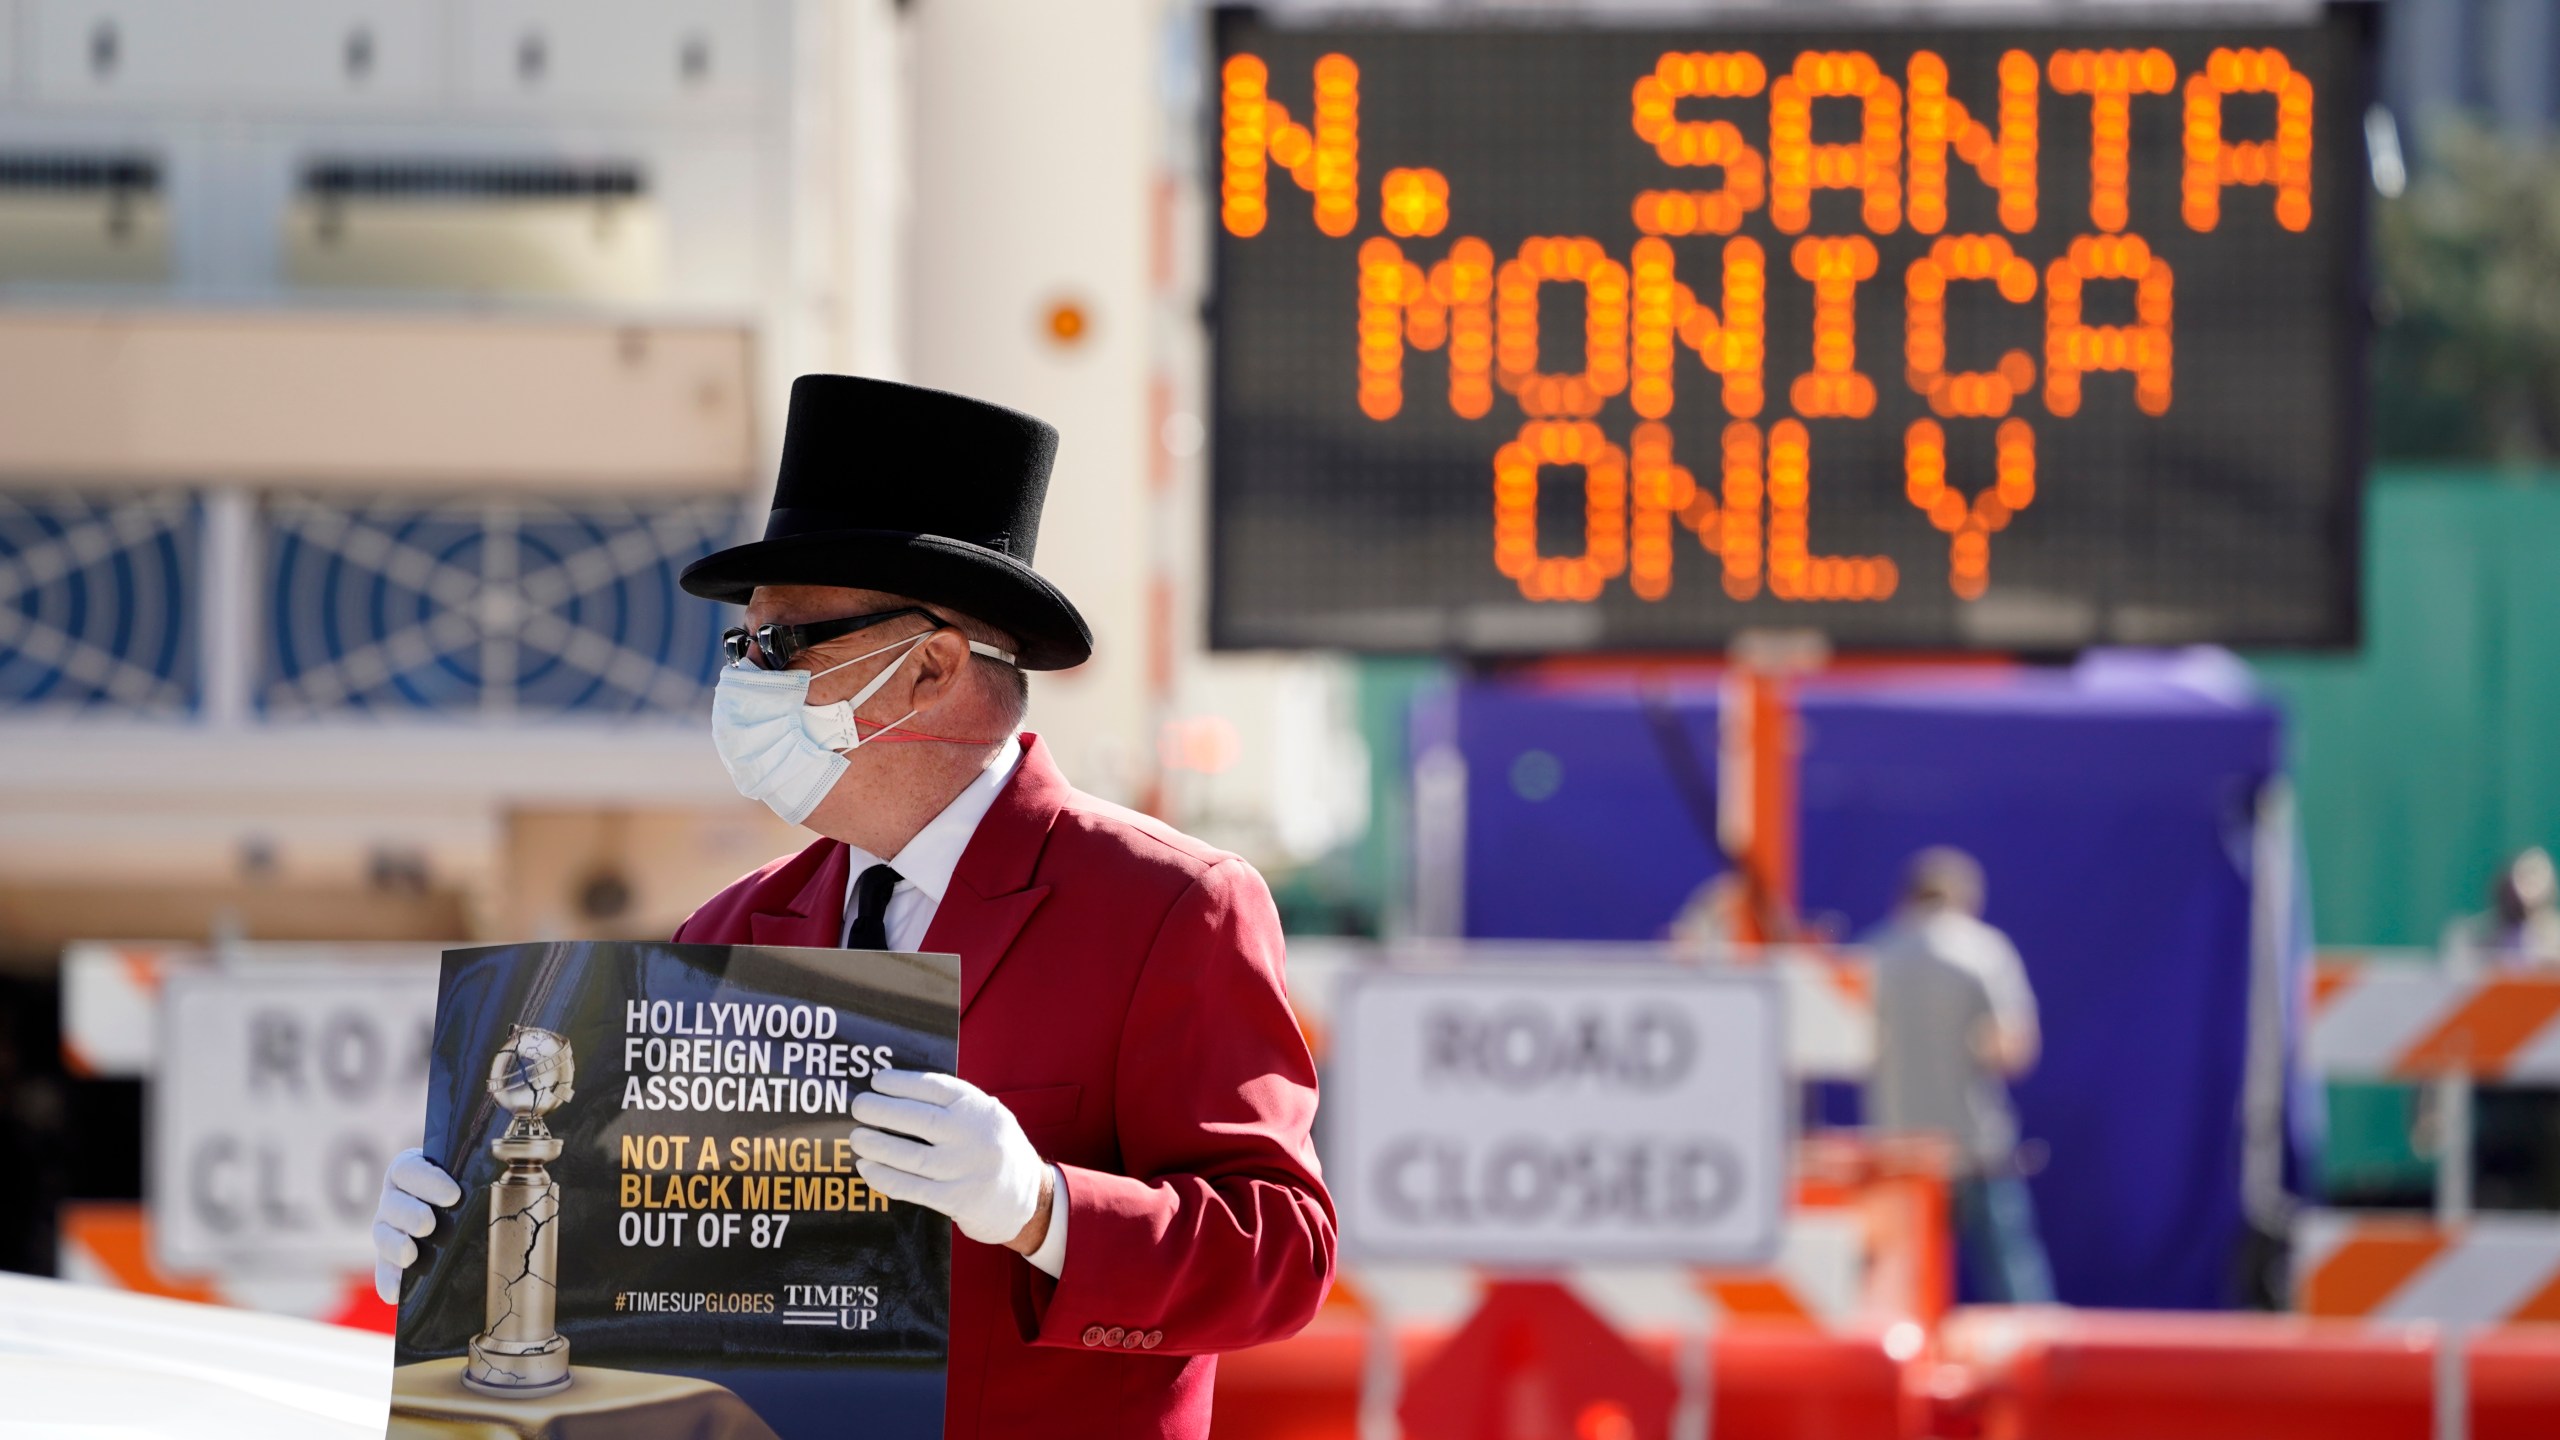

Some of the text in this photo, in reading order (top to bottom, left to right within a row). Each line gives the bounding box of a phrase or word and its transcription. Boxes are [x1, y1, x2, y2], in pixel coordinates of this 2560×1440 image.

[1223, 48, 2313, 237] N. SANTA
[1358, 234, 2174, 420] MONICA
[1495, 418, 2036, 601] ONLY
[626, 999, 837, 1040] HOLLYWOOD
[624, 1038, 893, 1078] FOREIGN PRESS
[1421, 1004, 1699, 1094] ROAD
[621, 1075, 848, 1114] ASSOCIATION
[622, 1135, 852, 1173] NOT A SINGLE
[620, 1174, 889, 1212] BLACK MEMBER
[1374, 1133, 1744, 1229] CLOSED
[619, 1211, 790, 1249] OUT OF 87
[615, 1291, 775, 1314] #TIMESUPGLOBES
[784, 1285, 878, 1308] TIME'S
[840, 1309, 877, 1330] UP
